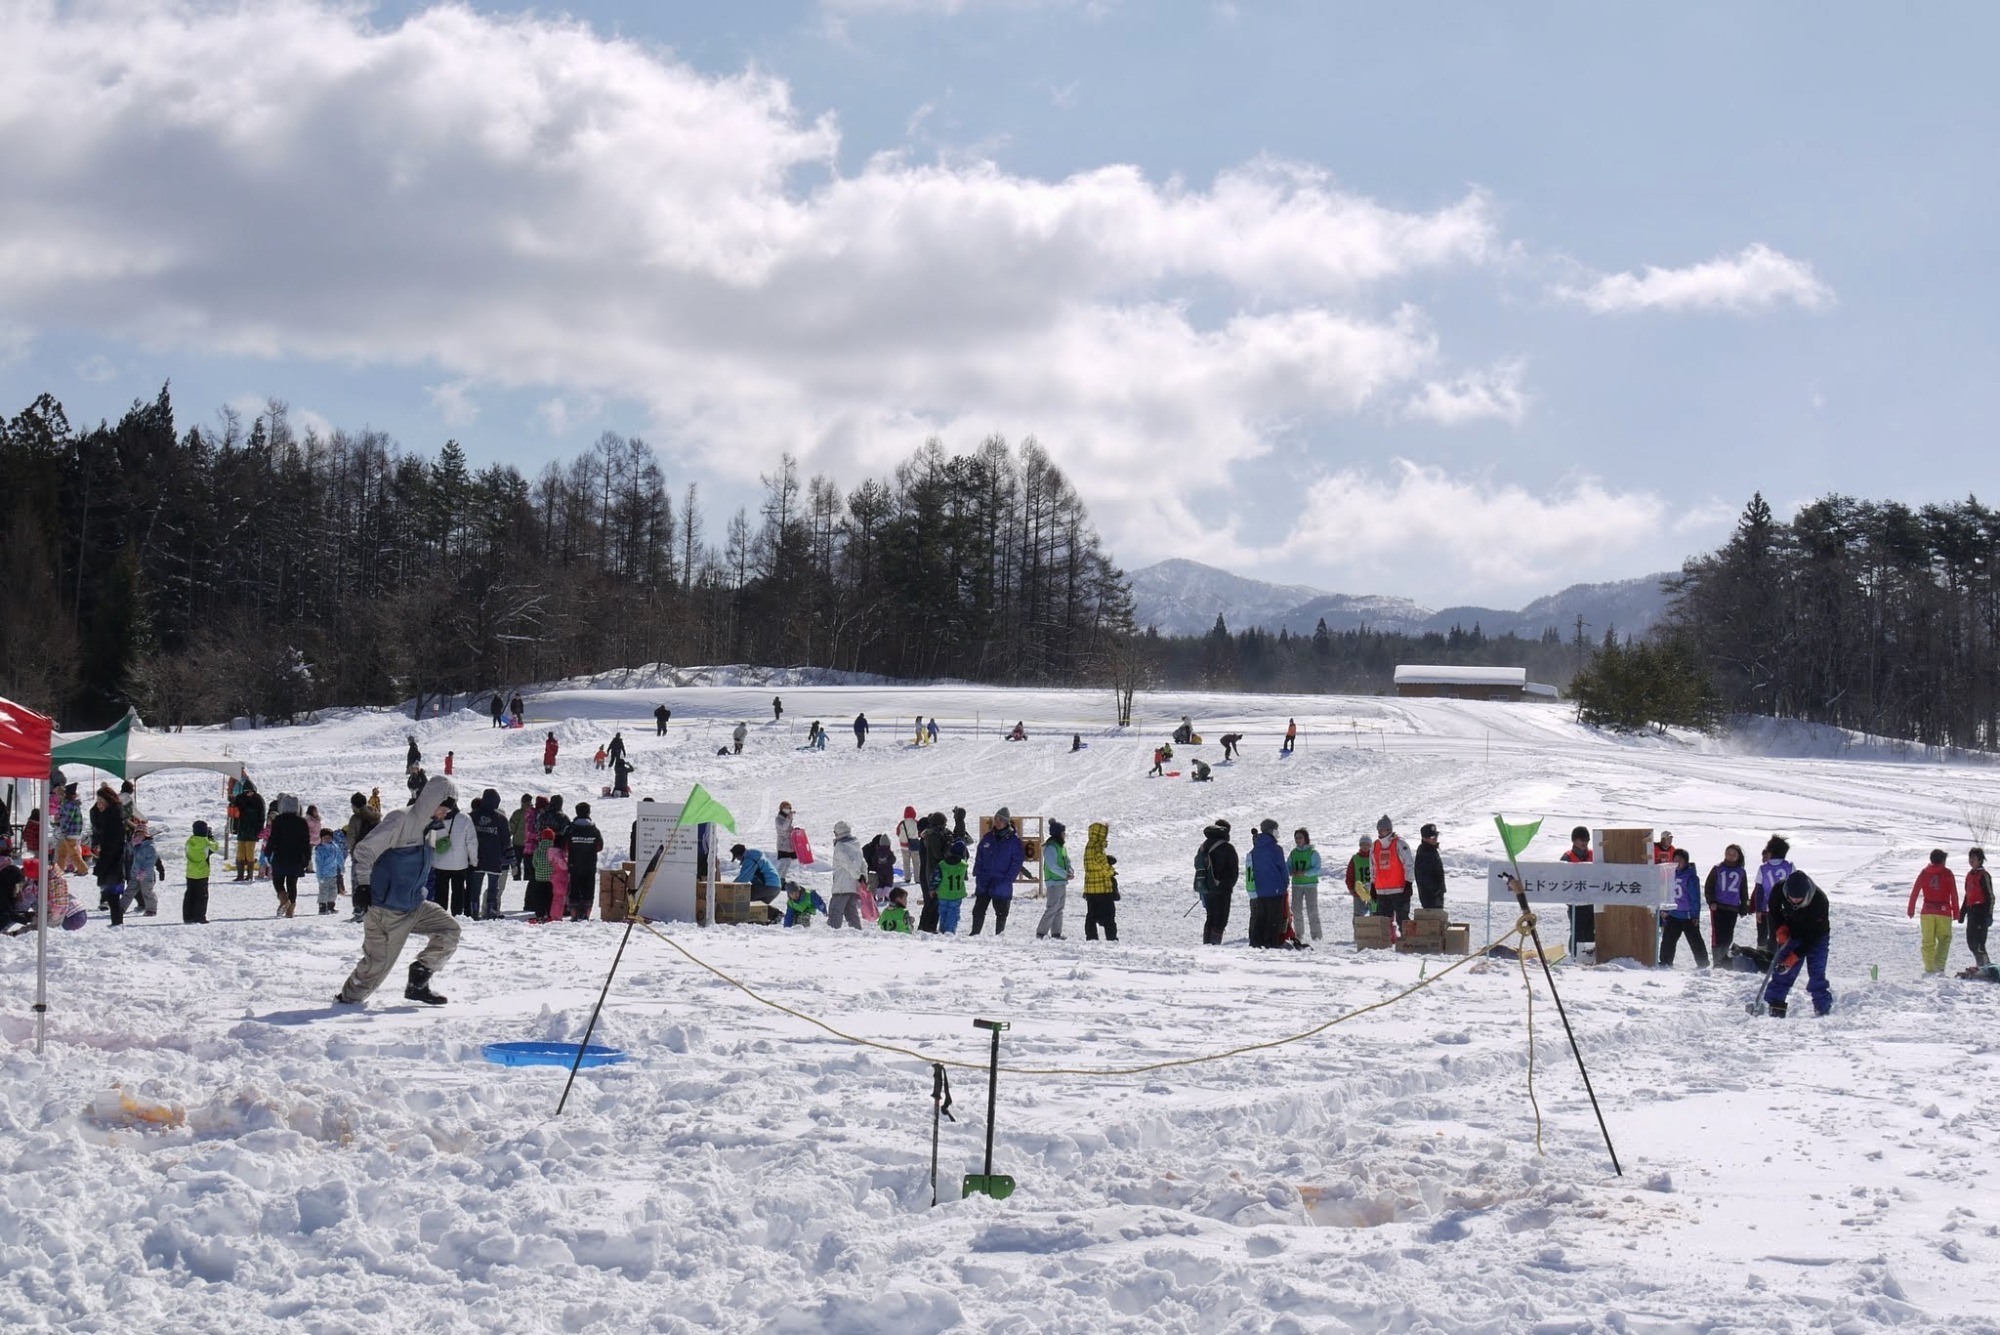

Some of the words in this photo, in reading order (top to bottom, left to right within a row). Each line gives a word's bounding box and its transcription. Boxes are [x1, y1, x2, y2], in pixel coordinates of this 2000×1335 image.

[1025, 840, 1035, 859] 6
[1295, 860, 1307, 871] 17
[948, 875, 961, 891] 11
[1507, 879, 1641, 894] 上ドッジボール大会
[1721, 871, 1739, 892] 12
[1930, 874, 1941, 890] 4
